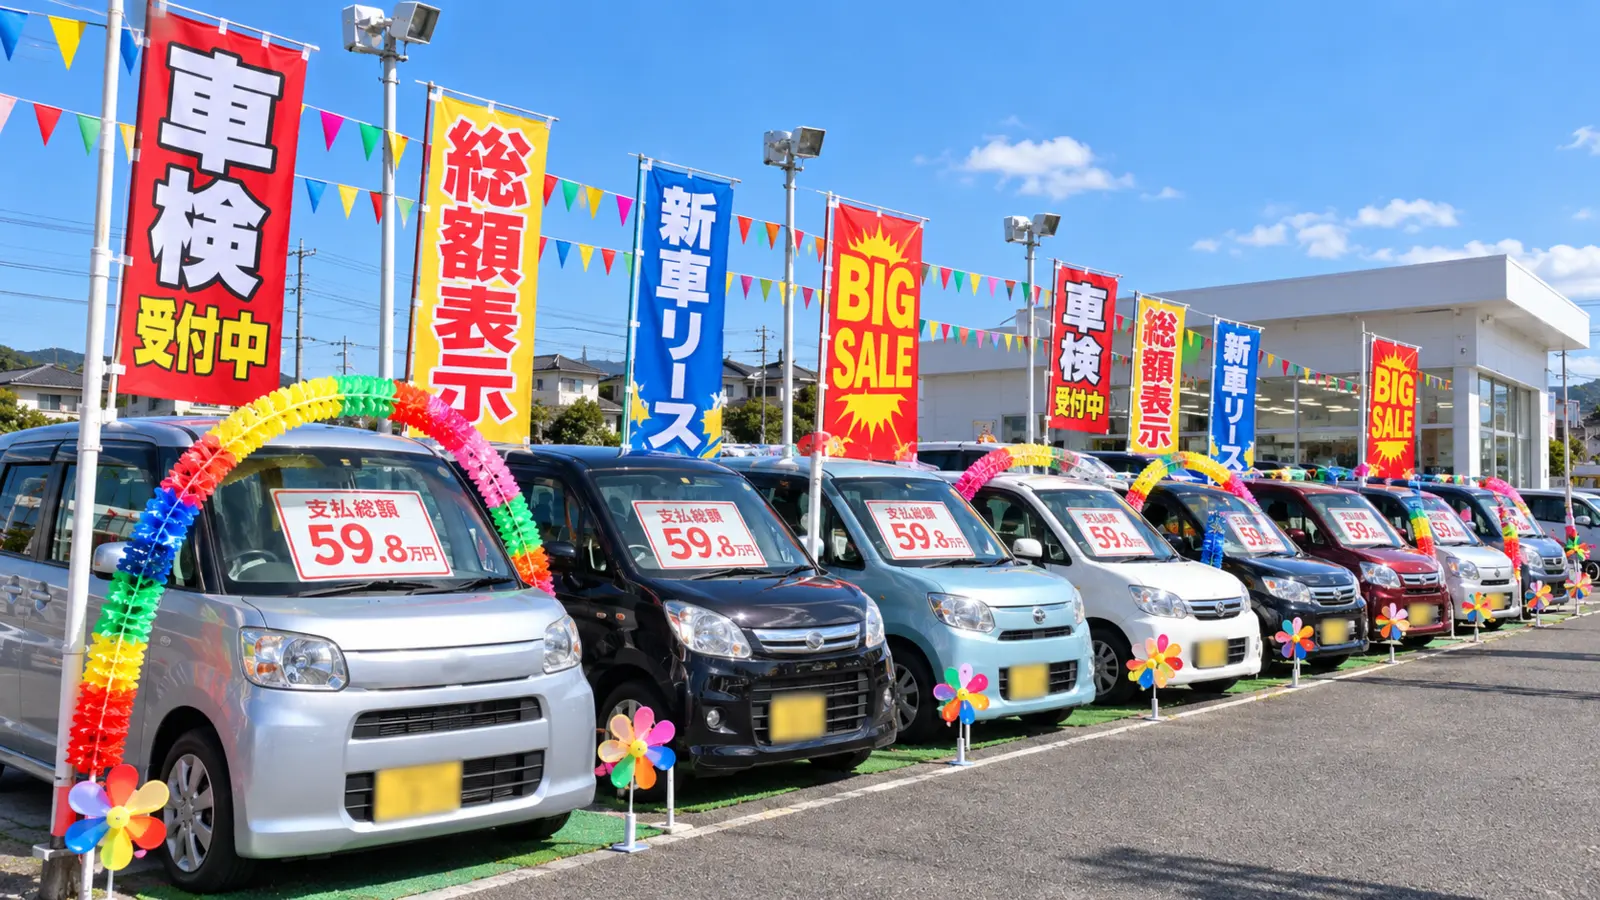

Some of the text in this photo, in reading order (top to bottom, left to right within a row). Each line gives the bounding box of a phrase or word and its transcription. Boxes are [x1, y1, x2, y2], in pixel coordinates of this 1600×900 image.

[149, 43, 284, 298] 車検
[431, 116, 533, 424] 総額表示
[836, 252, 916, 329] BIG
[134, 296, 271, 381] 受付中
[648, 185, 717, 451] 新車リース
[1058, 280, 1108, 386] 車検
[832, 327, 914, 390] SALE
[1137, 308, 1178, 449] 総額表示
[1054, 385, 1105, 421] 受付中
[1222, 332, 1251, 470] 新車リース
[1373, 366, 1414, 407] BIG
[1371, 405, 1413, 439] SALE
[305, 498, 400, 519] 支払総額
[656, 508, 724, 524] 支払総額
[1345, 521, 1387, 539] 59.8
[307, 522, 438, 566] 59.8万円
[662, 526, 757, 560] 59.8万円
[1240, 527, 1281, 546] 59.8
